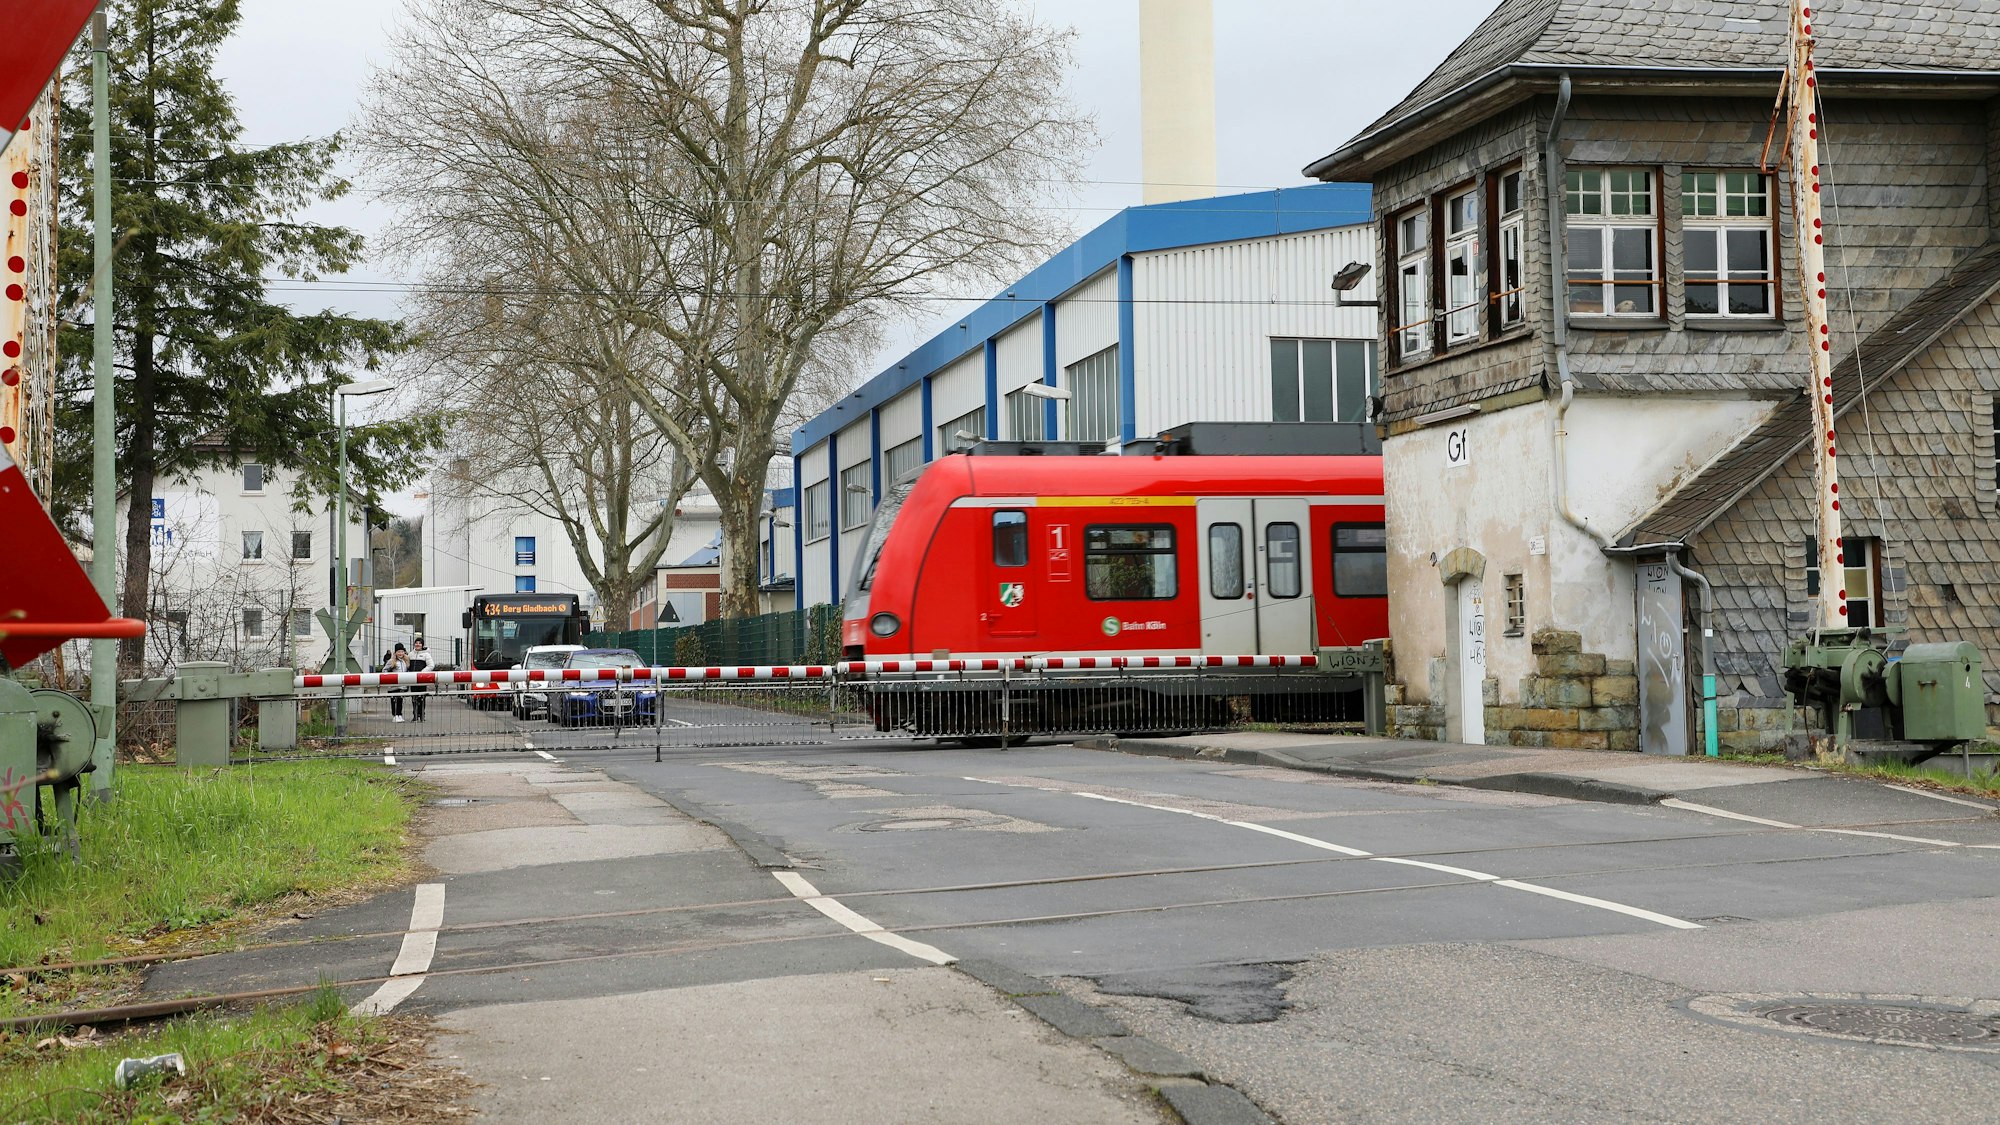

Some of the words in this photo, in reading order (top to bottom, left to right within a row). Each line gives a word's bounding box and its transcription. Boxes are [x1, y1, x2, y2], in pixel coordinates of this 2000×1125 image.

[1448, 429, 1467, 462] Gf
[1050, 526, 1063, 549] 1
[485, 604, 500, 616] 434
[503, 605, 522, 613] Berg
[522, 604, 557, 613] Gladbach
[1122, 622, 1145, 631] Bahn
[1145, 621, 1167, 630] Köln
